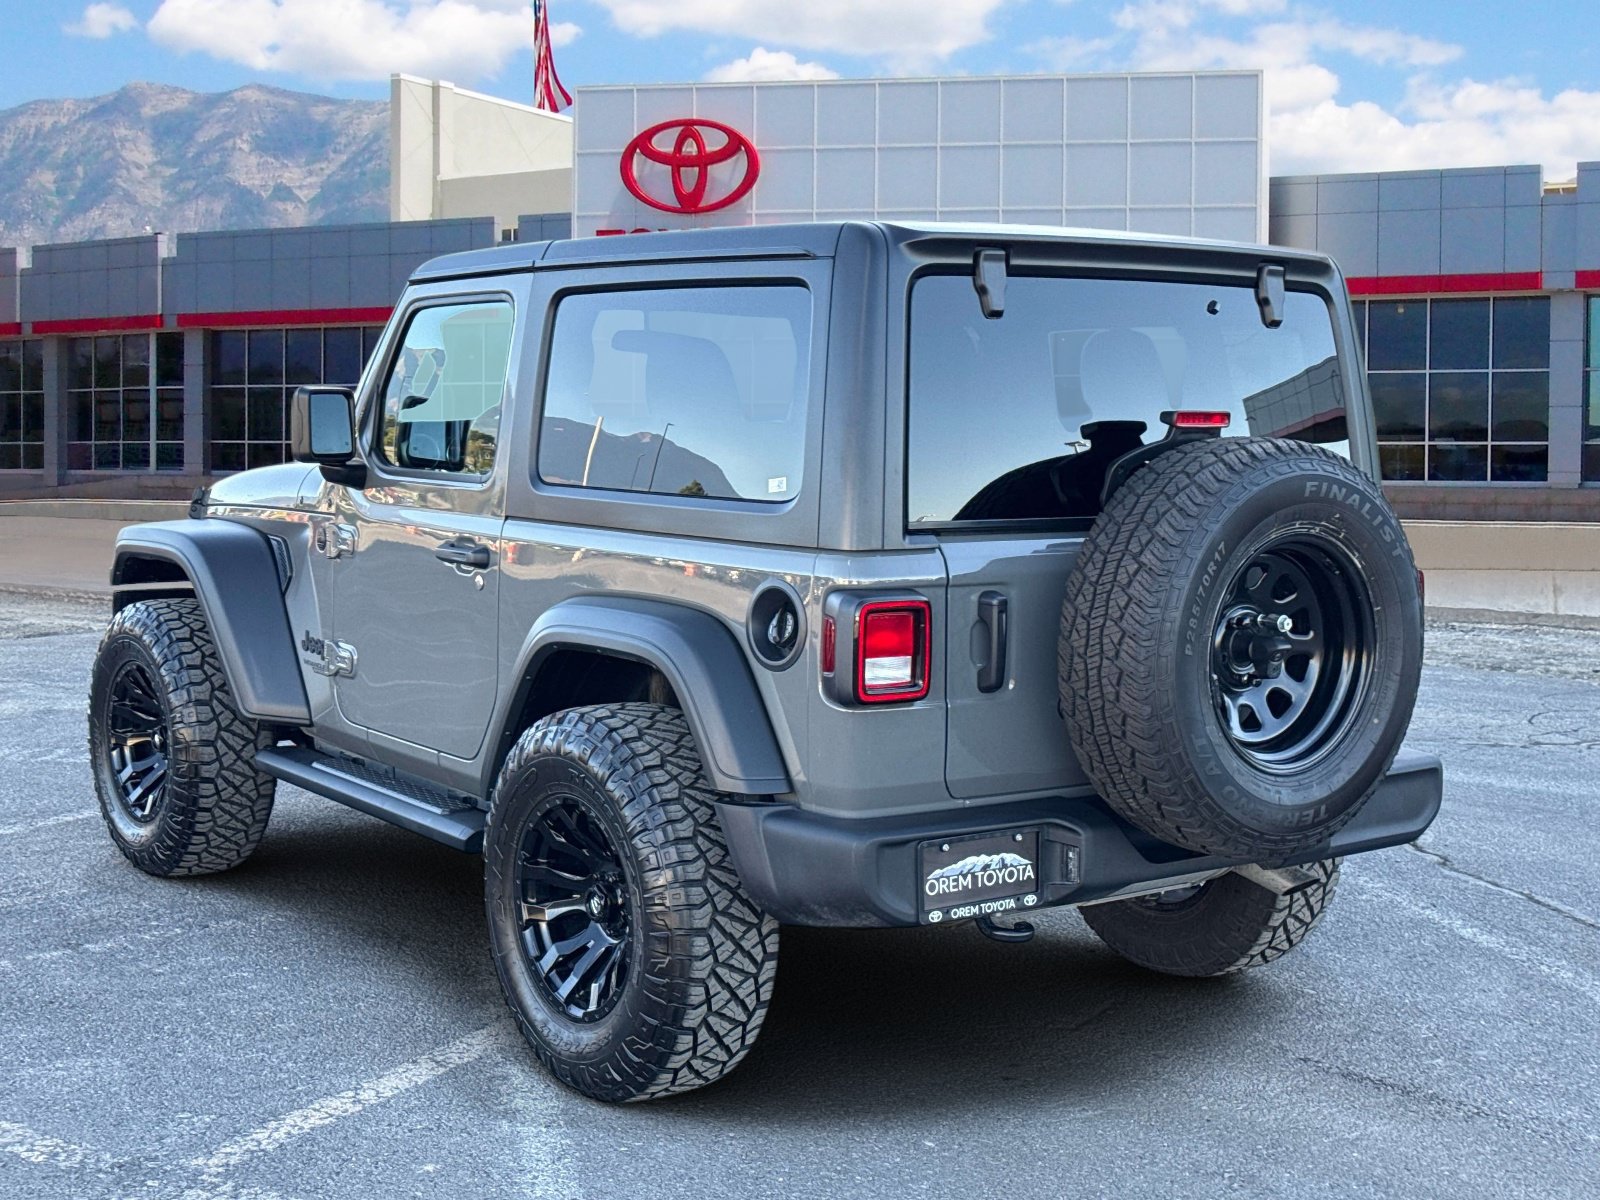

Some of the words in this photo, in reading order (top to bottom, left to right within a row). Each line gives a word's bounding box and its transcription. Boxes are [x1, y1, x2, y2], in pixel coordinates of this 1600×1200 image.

[1304, 481, 1405, 559] FINALIST
[1184, 541, 1226, 656] P285/70R17
[926, 874, 972, 896] OREM
[975, 865, 1034, 886] TOYOTA
[951, 904, 979, 919] OREM
[979, 898, 1016, 914] TOYOTA
